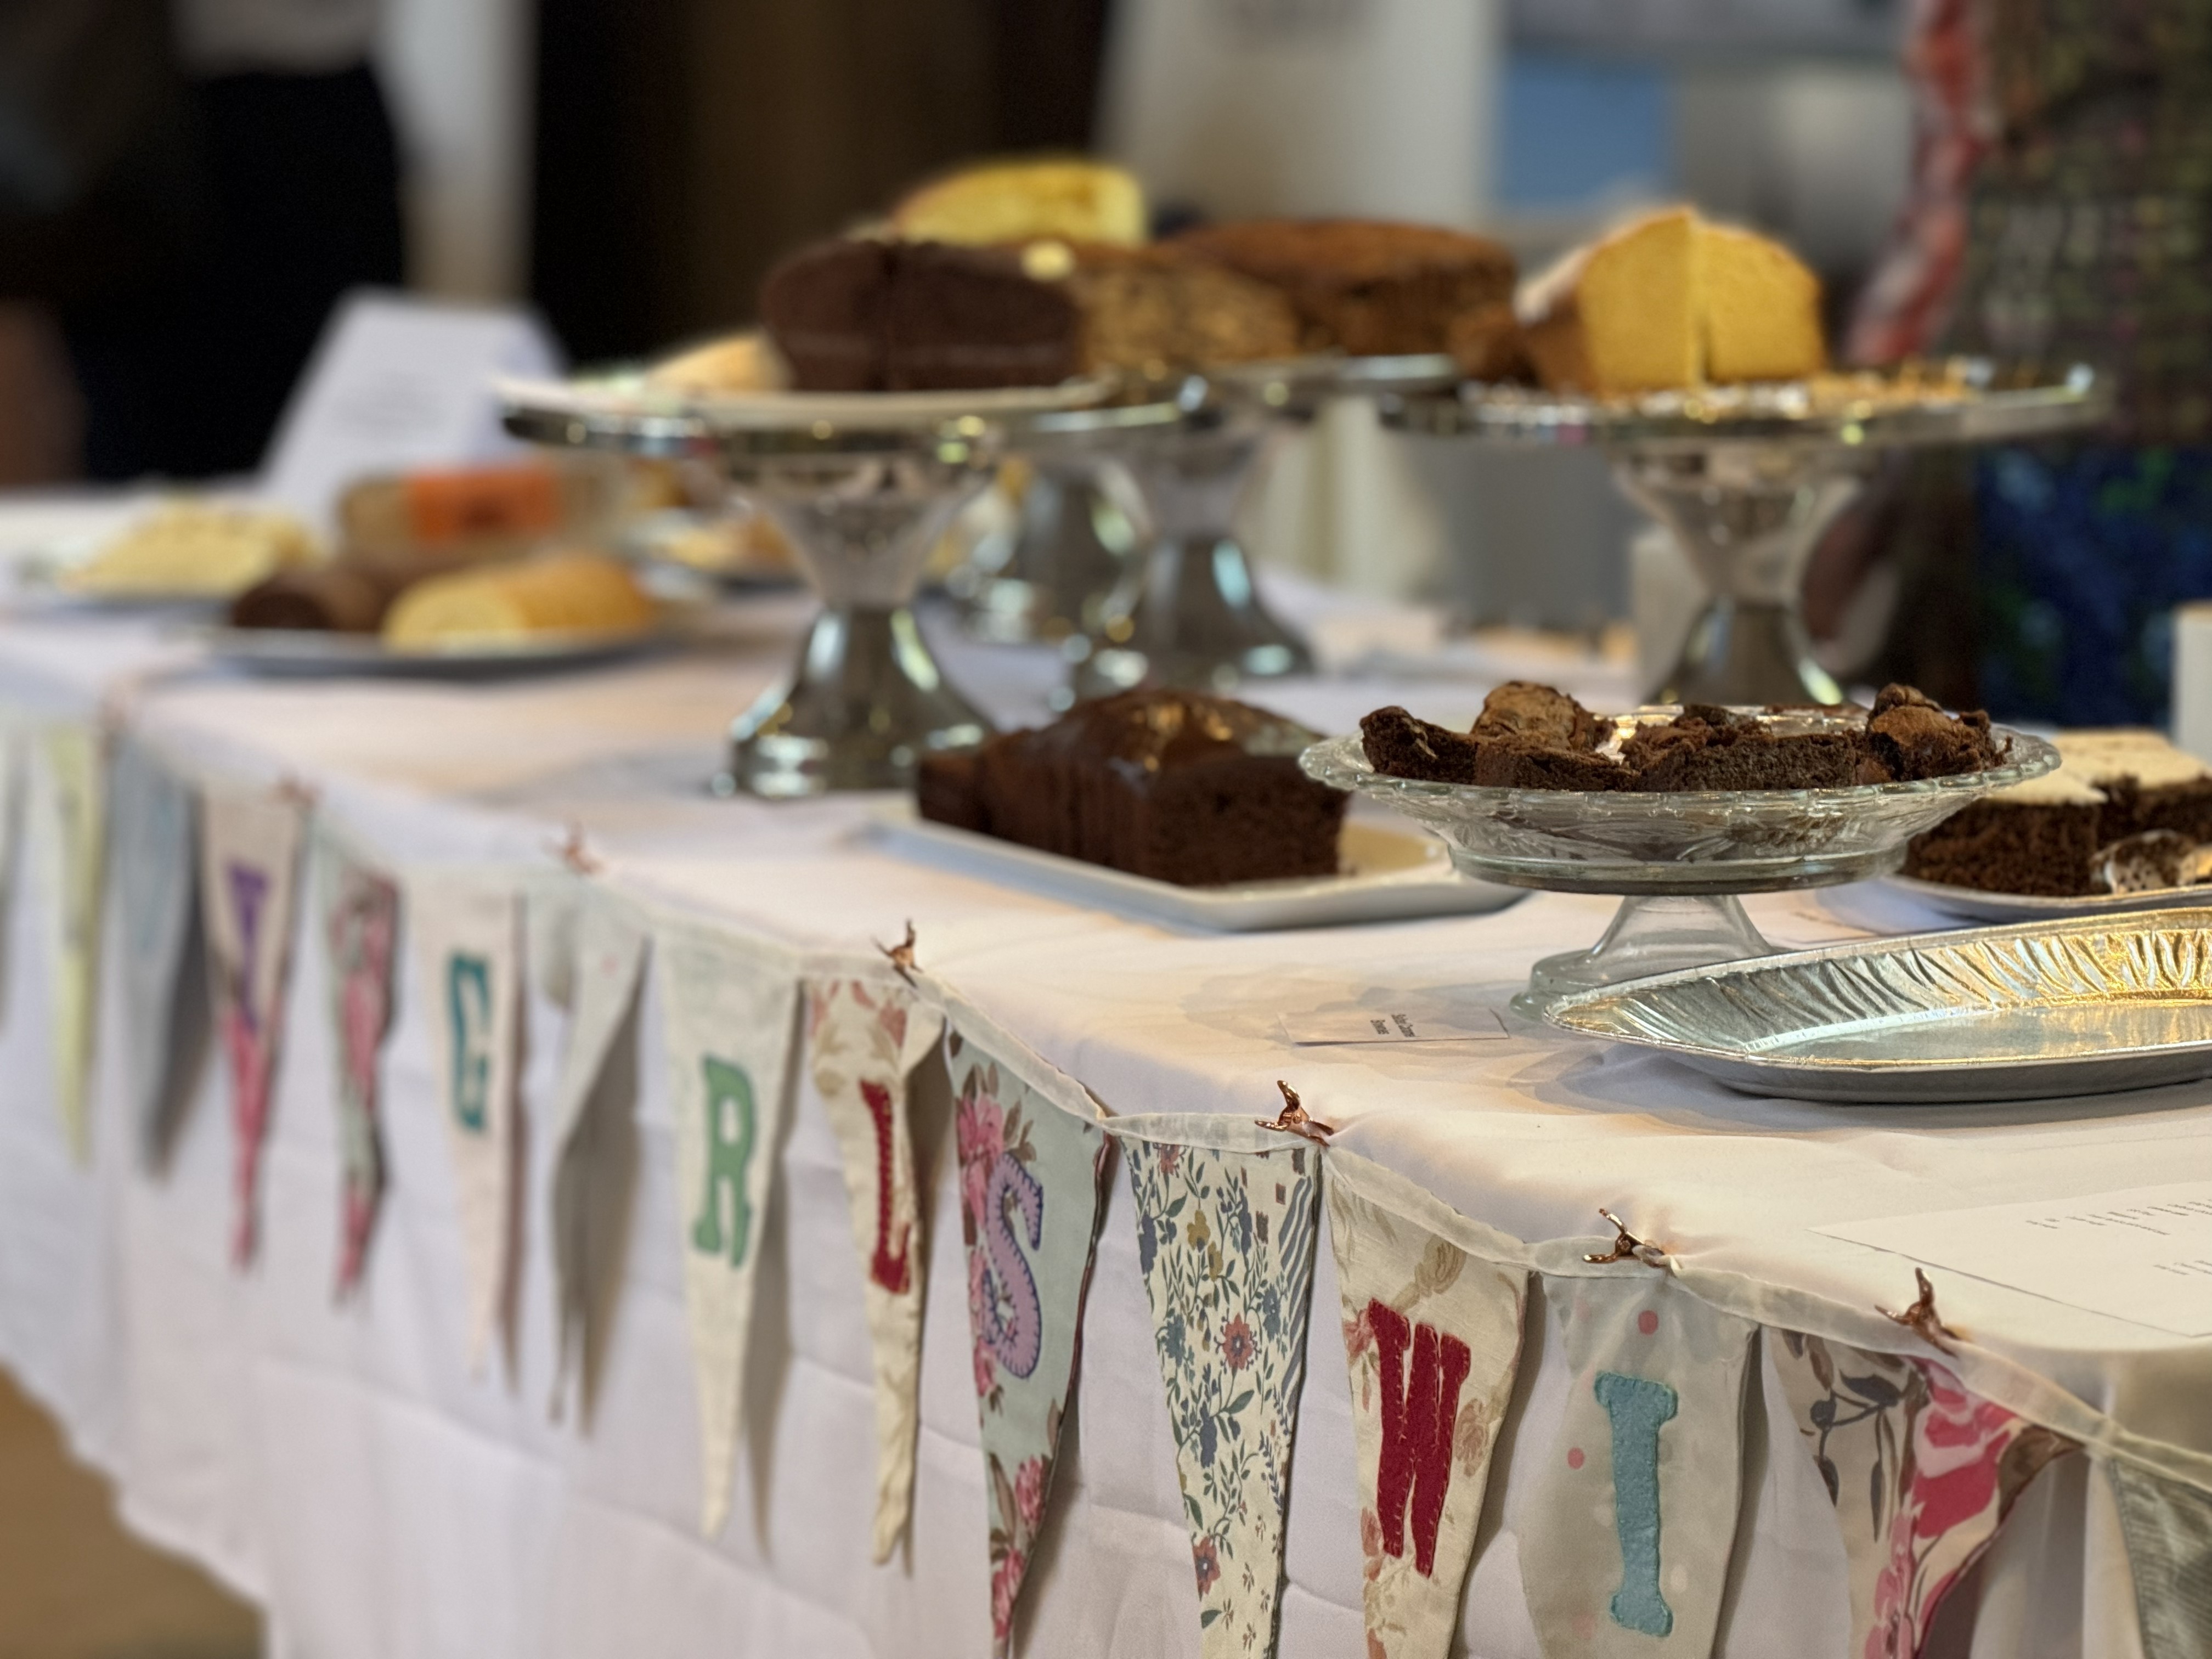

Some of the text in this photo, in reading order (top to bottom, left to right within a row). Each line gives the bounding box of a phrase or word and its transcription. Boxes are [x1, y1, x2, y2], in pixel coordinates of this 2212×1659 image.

[445, 951, 492, 1133] G
[691, 1057, 755, 1269] R
[861, 1082, 910, 1293] L
[983, 1152, 1043, 1379] S
[1368, 1297, 1471, 1579] W
[1594, 1371, 1678, 1638] I
